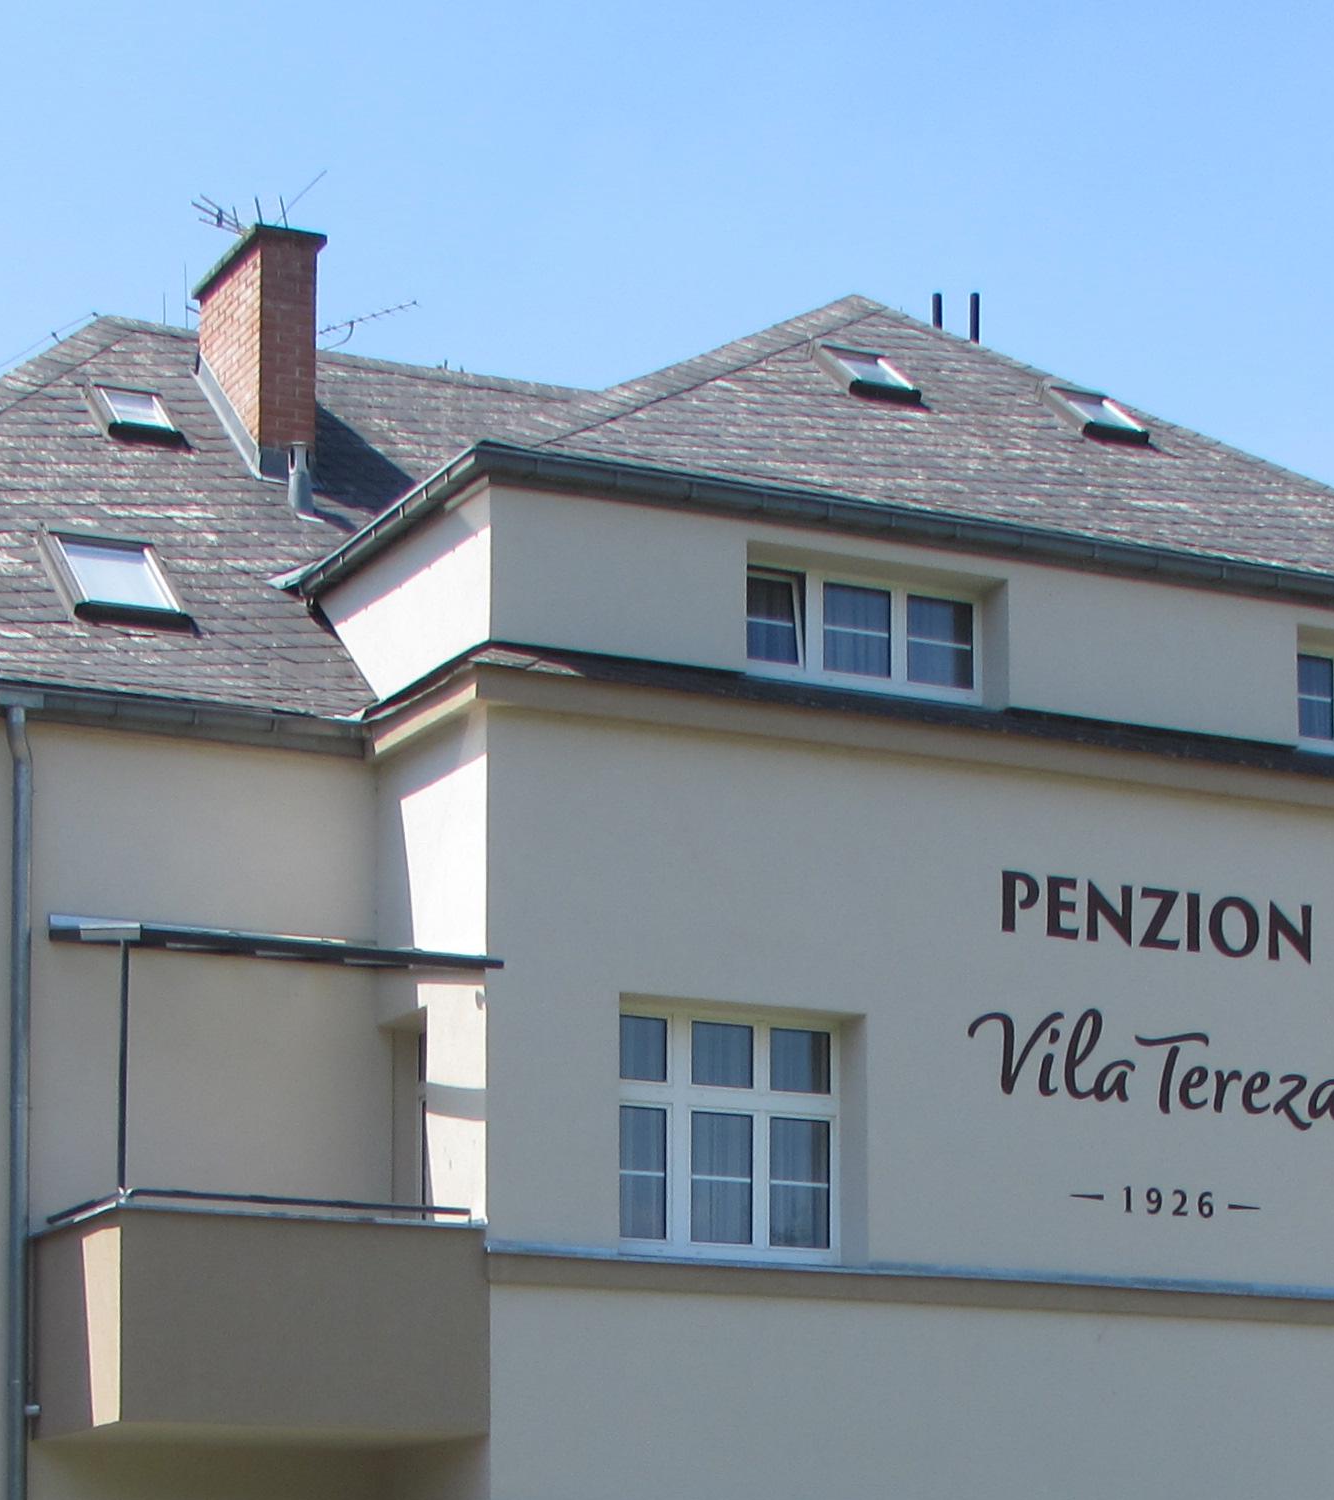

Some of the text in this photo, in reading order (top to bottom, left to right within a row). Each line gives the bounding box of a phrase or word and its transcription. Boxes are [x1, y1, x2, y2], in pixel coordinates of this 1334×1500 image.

[1000, 869, 1313, 966] PENZION
[968, 1008, 1136, 1103] Vila
[1122, 1186, 1215, 1219] 1926
